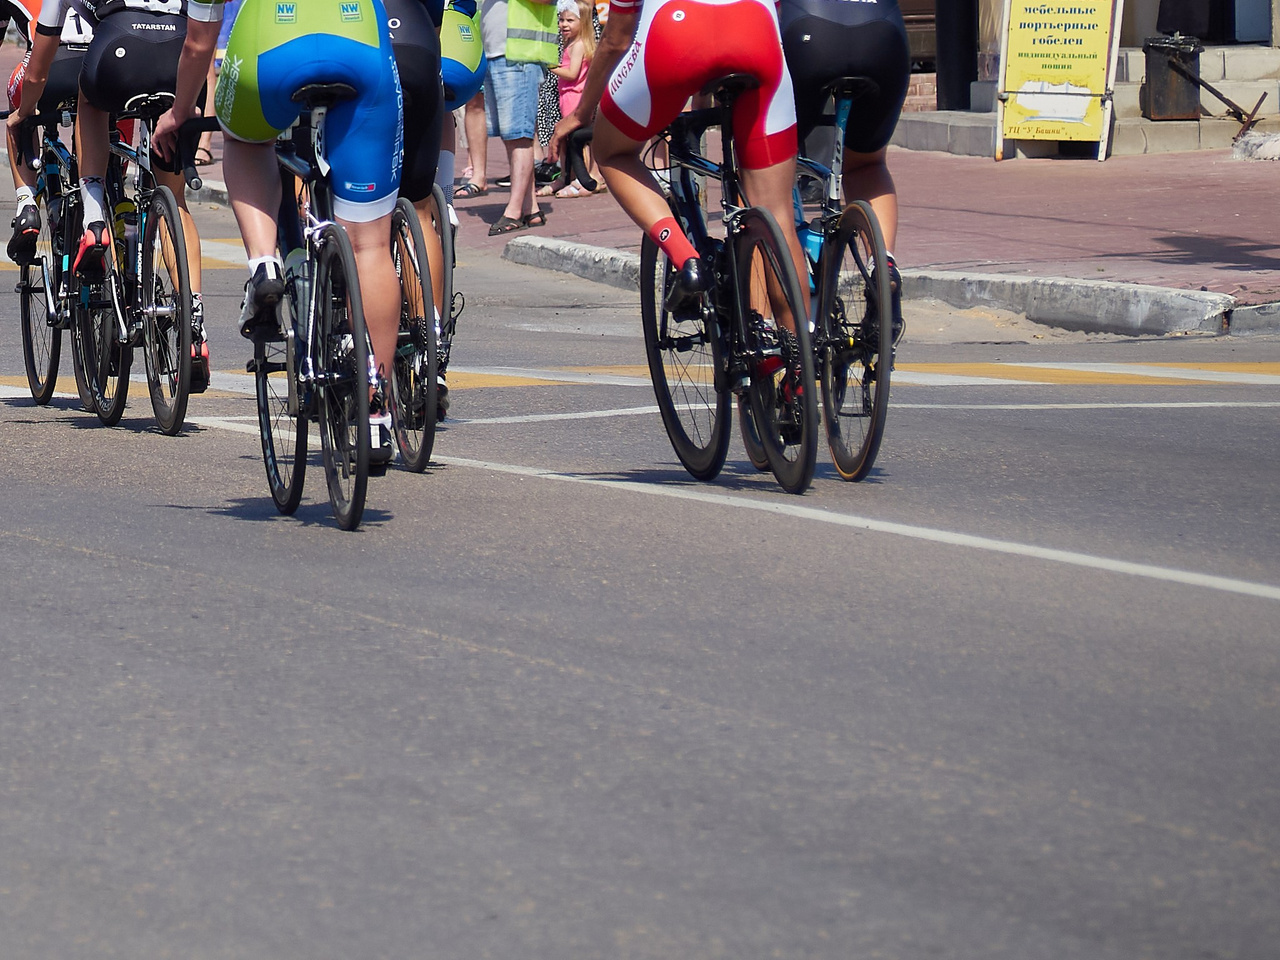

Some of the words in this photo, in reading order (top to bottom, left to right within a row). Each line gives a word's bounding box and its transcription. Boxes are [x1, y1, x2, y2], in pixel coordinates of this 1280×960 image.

[277, 5, 295, 14] NW
[341, 4, 359, 13] NW
[1023, 4, 1097, 16] мебельные
[132, 23, 176, 31] TATARSTAN
[1019, 20, 1099, 32] портьерные
[1032, 34, 1084, 46] гобелен
[1017, 51, 1098, 62] индивидуальный
[1008, 126, 1021, 136] ТЦ
